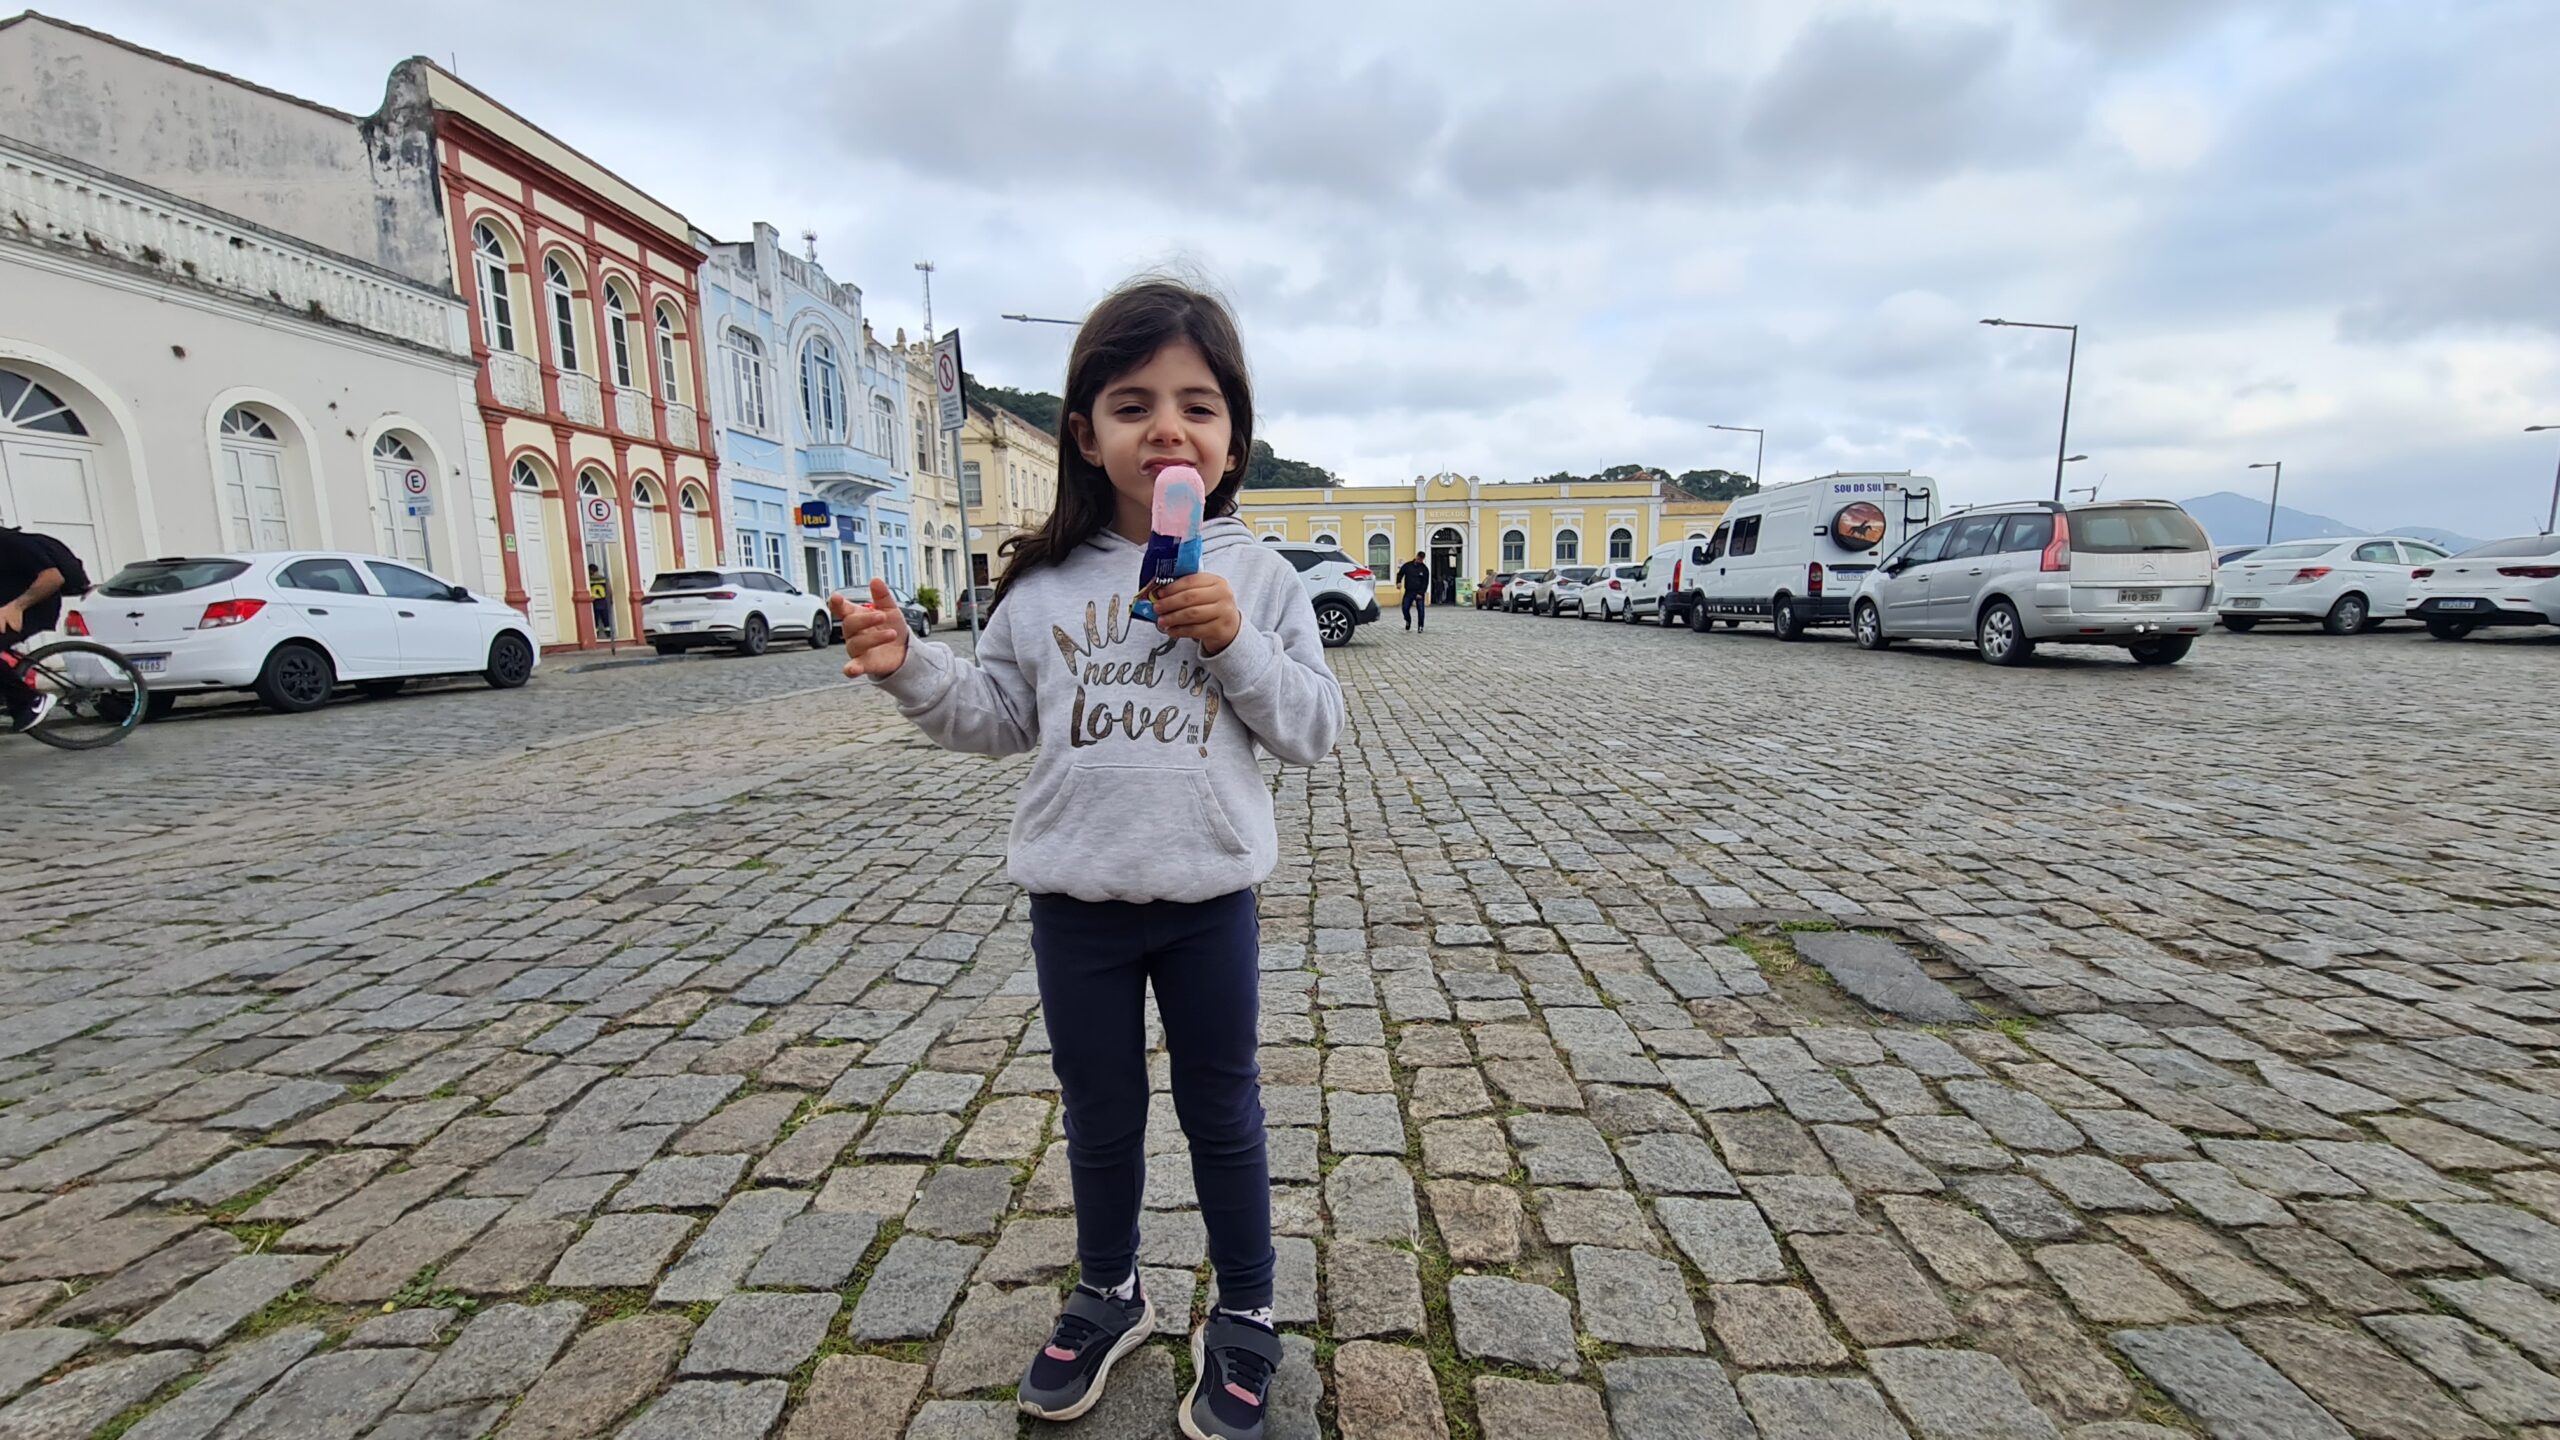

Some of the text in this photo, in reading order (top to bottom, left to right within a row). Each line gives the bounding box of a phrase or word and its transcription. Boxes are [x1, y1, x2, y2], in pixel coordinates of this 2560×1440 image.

[411, 475, 420, 488] E
[1834, 483, 1881, 493] SOU DO SUL
[595, 503, 604, 516] E
[1052, 593, 1132, 676] All
[1083, 648, 1210, 697] need is
